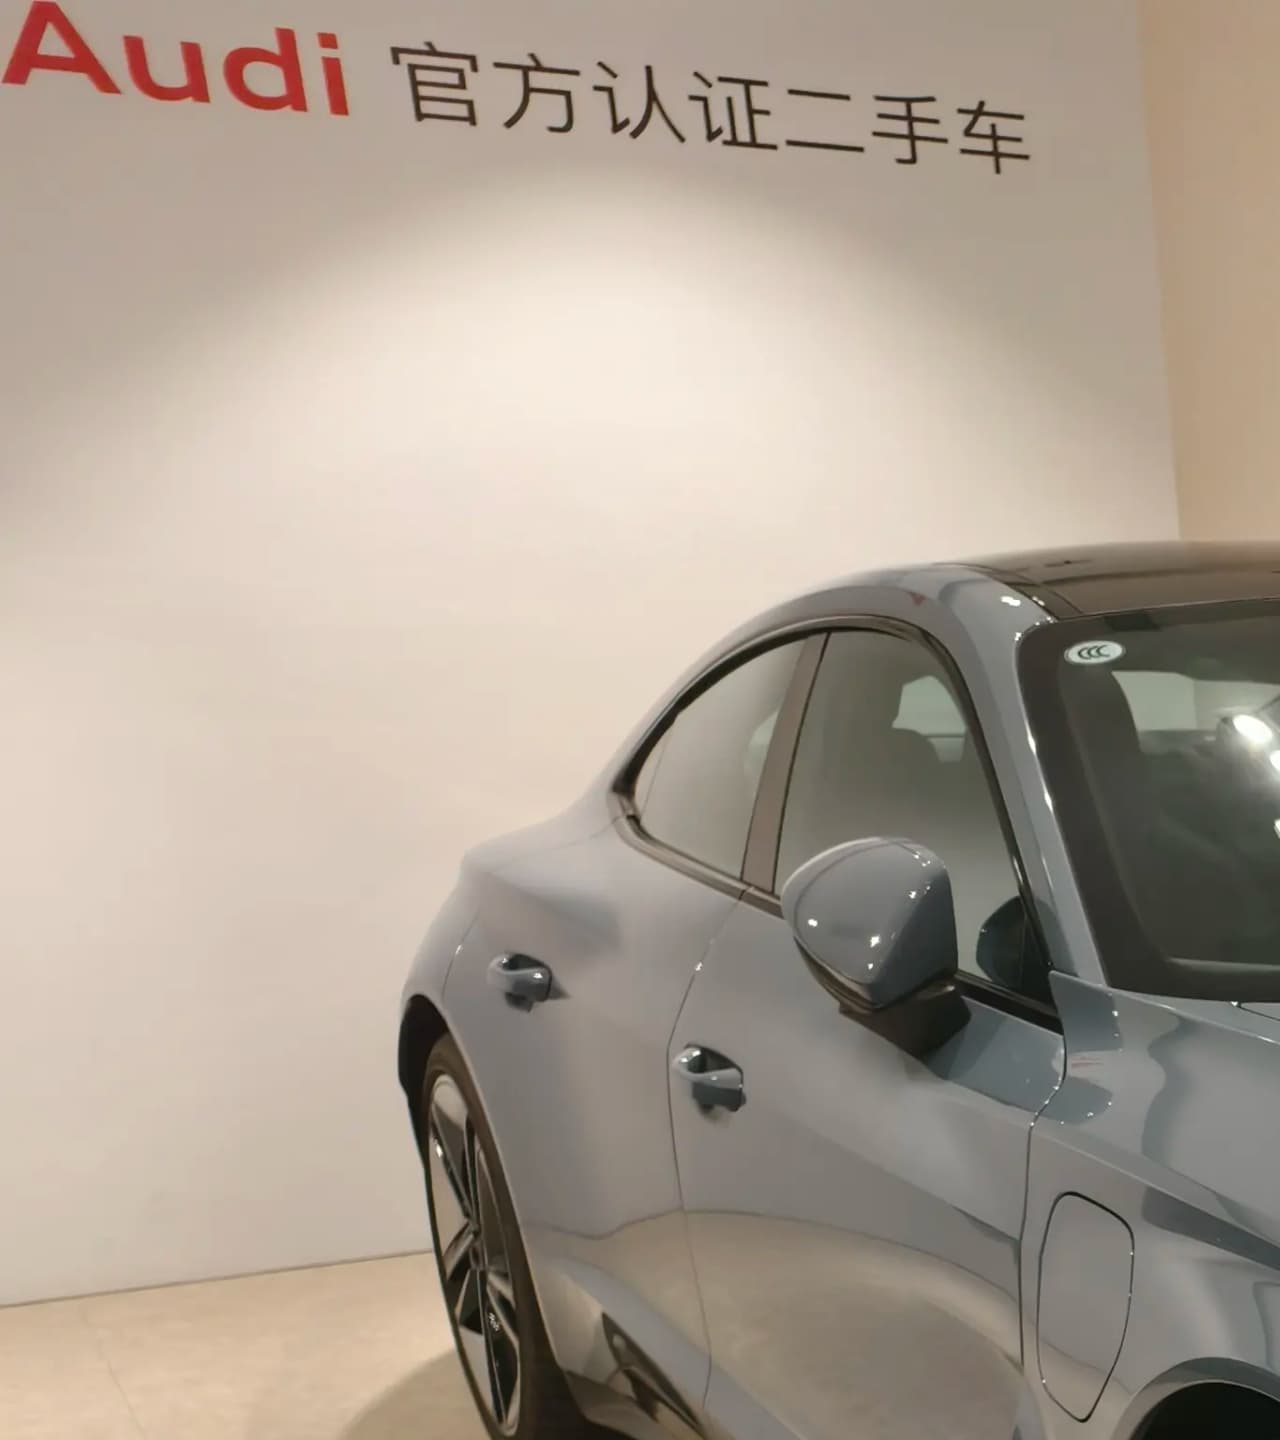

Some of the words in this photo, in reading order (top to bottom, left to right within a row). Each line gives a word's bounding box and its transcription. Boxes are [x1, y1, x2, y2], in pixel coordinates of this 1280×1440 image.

[2, 0, 350, 117] Audi
[391, 41, 1030, 174] 官方认证二手车
[1078, 645, 1110, 660] CCC
